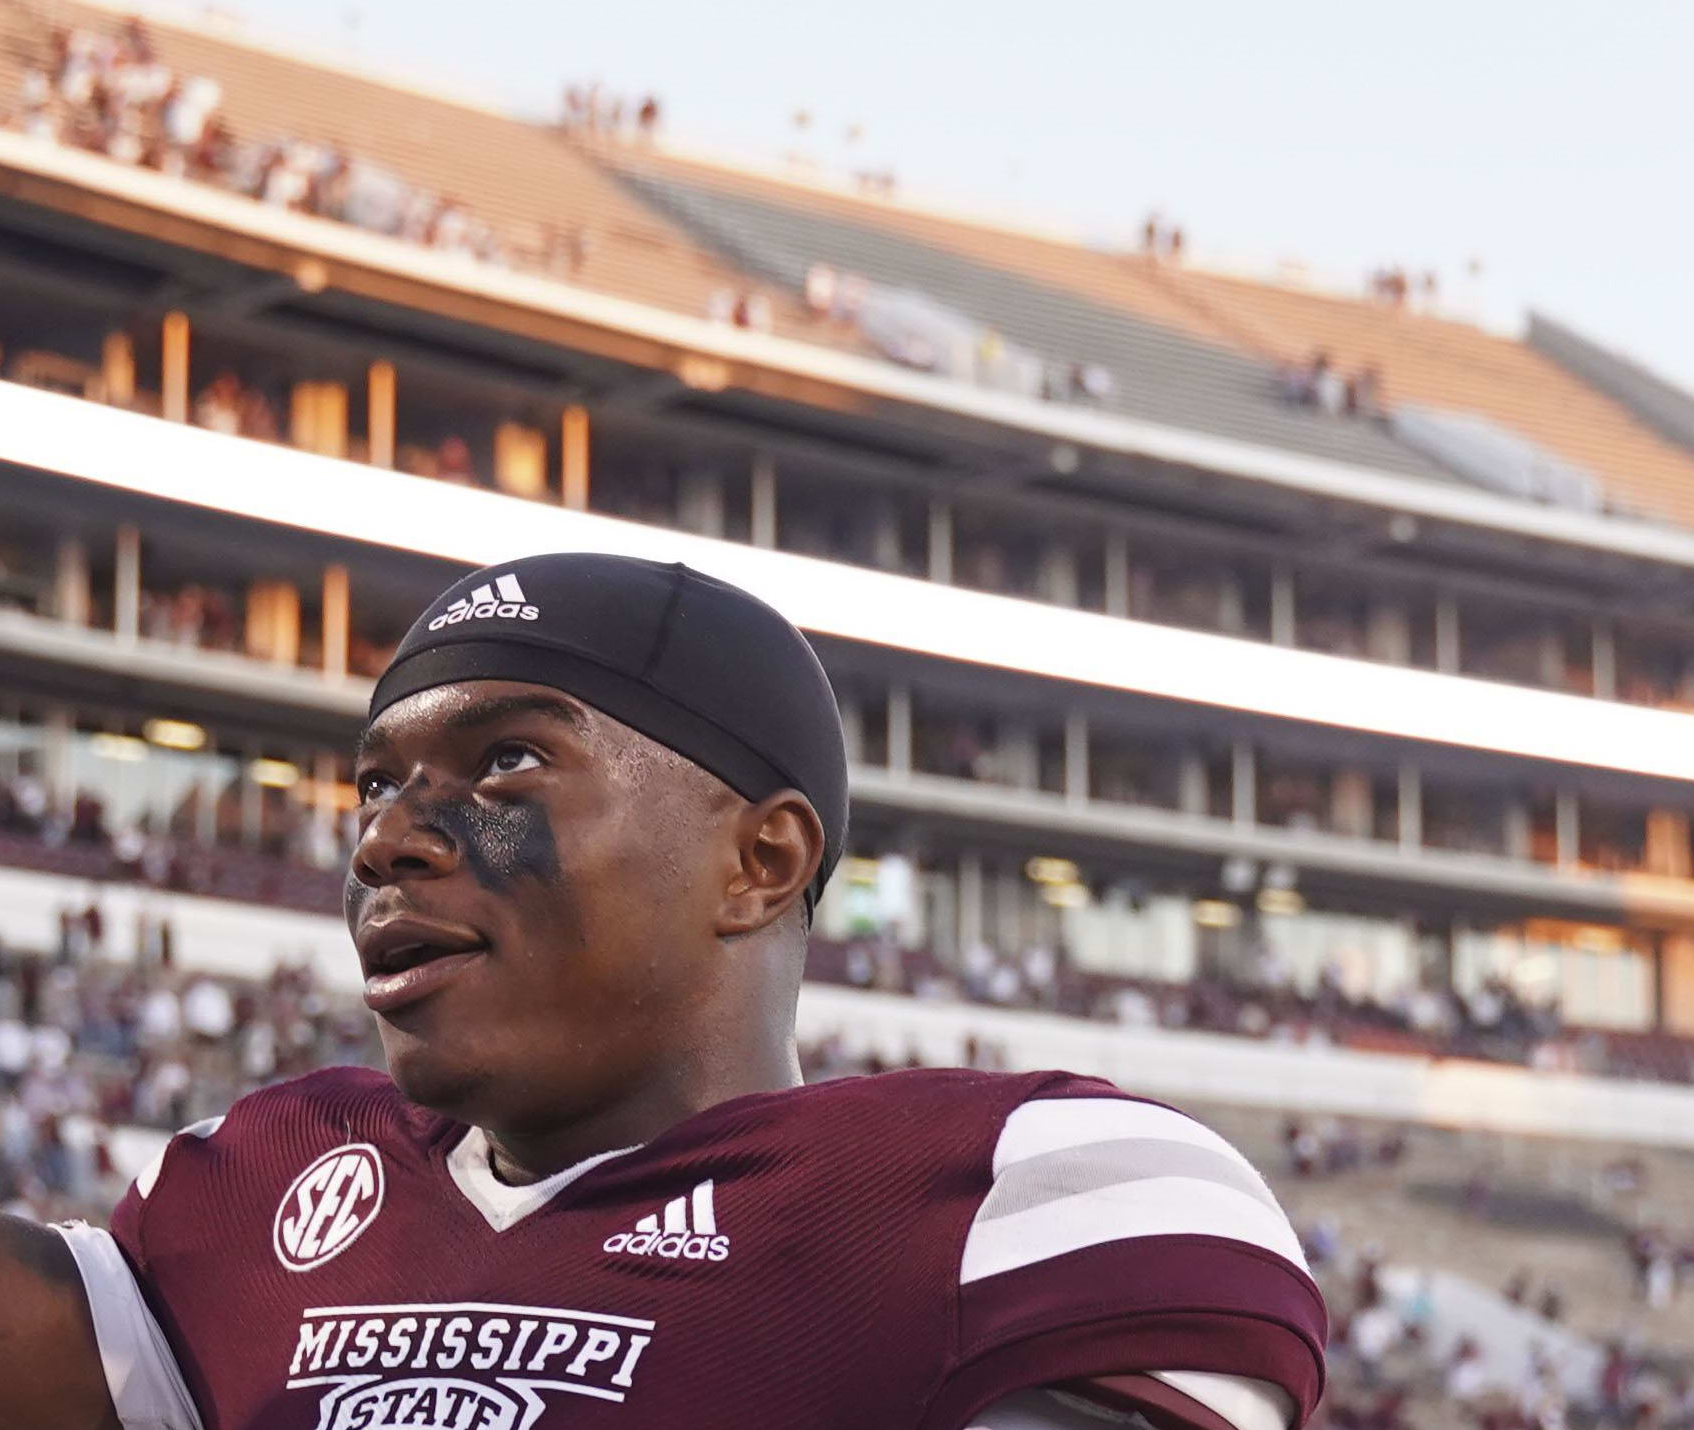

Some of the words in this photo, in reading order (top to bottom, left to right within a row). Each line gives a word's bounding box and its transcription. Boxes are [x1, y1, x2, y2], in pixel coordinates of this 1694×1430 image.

[428, 599, 540, 631] adidas
[282, 1154, 375, 1259] SEC
[603, 1229, 730, 1261] adidas
[289, 1317, 651, 1388] MISSISSIPPI
